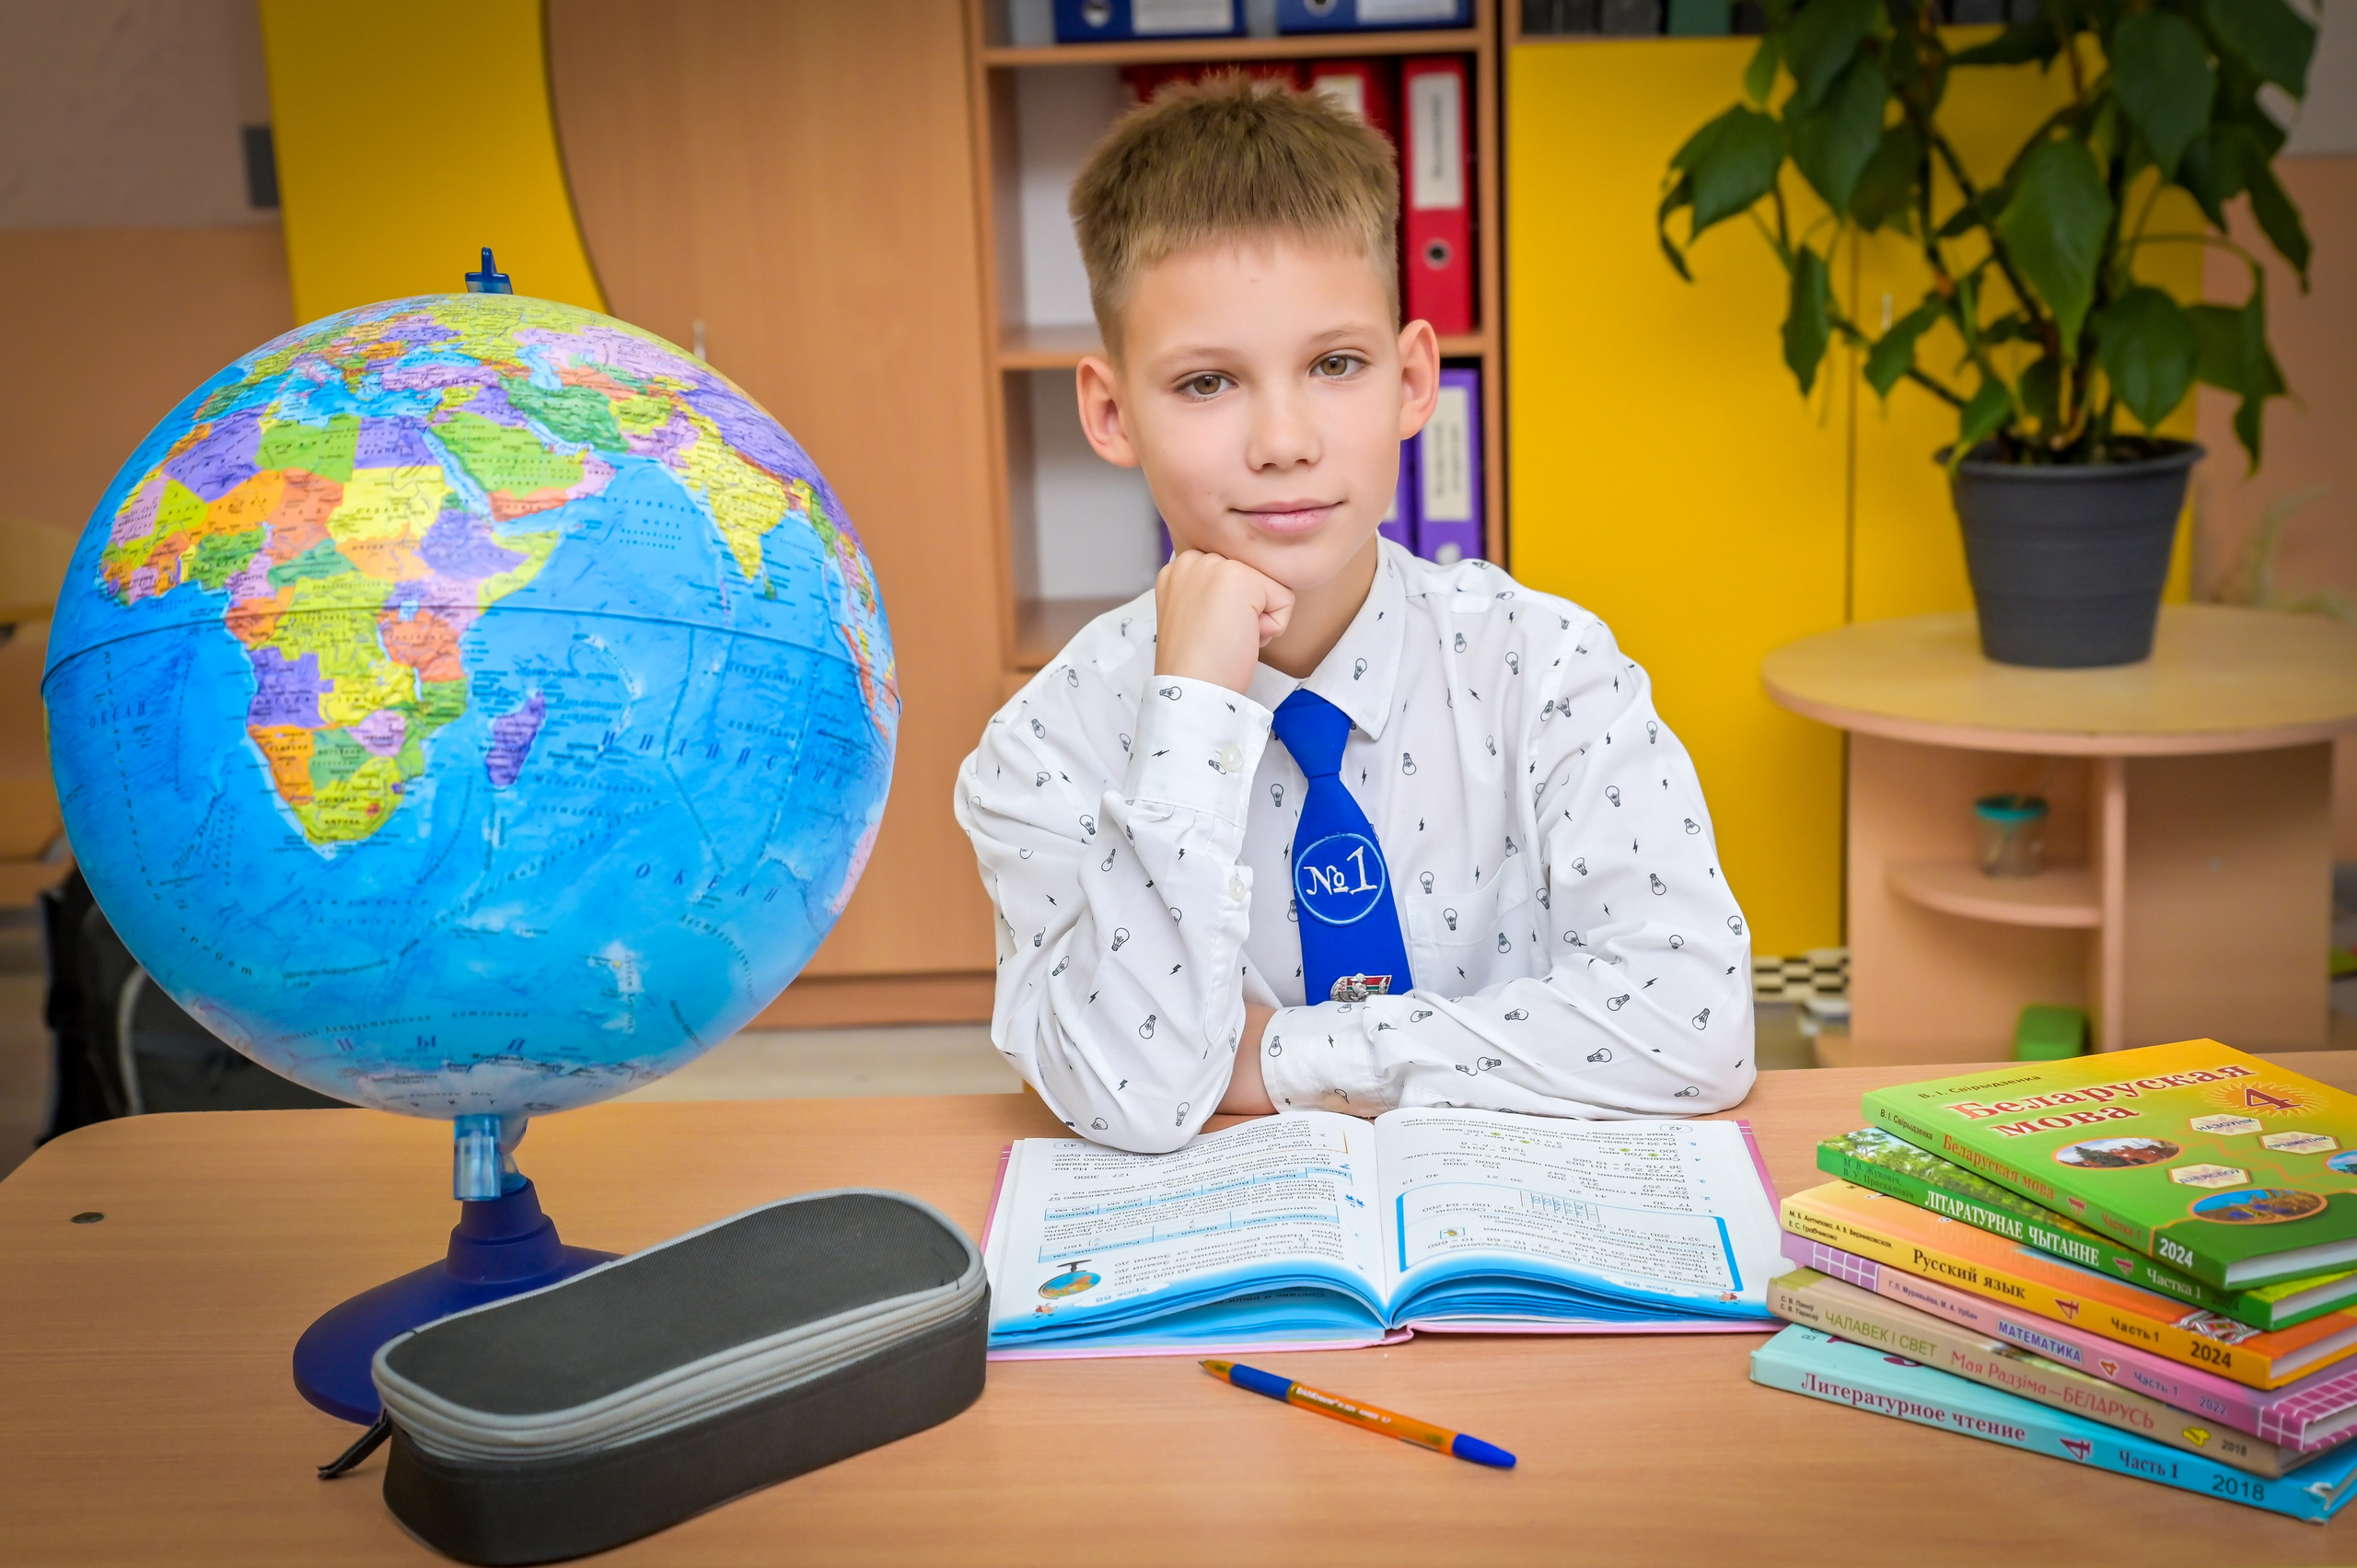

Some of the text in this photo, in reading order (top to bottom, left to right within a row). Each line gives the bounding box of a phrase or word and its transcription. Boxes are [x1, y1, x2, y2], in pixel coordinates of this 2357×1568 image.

[635, 863, 778, 902] ОКЕАН
[1303, 845, 1378, 896] №1
[1945, 1063, 2256, 1121] Беларуская
[1948, 1074, 2042, 1097] Свірыдзенка
[2246, 1087, 2303, 1110] 4
[1879, 1109, 1887, 1119] В.
[1893, 1113, 1933, 1141] Свірыдзенка
[1990, 1104, 2141, 1138] мова
[1842, 1157, 1853, 1170] М.
[1943, 1133, 2055, 1201] Беларуская мова
[1843, 1167, 1852, 1179] В.
[1864, 1173, 1914, 1201] Праскаловіч
[1788, 1209, 1796, 1218] М.
[2100, 1212, 2142, 1240] Частка 1
[1789, 1219, 1839, 1241] Е. С. Грабчикова
[1924, 1190, 2100, 1268] ЛІТАРАТУРНАЕ ЧЫТАННЕ
[2159, 1237, 2194, 1270] 2024
[1913, 1248, 2026, 1300] Русский язык
[2146, 1265, 2202, 1299] Частка 1
[1780, 1295, 1788, 1304] С.
[1780, 1303, 1787, 1311] С.
[2211, 1291, 2240, 1313] 2024
[1825, 1310, 1887, 1342] ЧАЛАВЕК
[1899, 1333, 1938, 1358] СВЕТ
[1998, 1318, 2082, 1364] МАТЕМАТИКА
[2109, 1316, 2160, 1342] Часть 1
[2099, 1359, 2118, 1378] 4
[2189, 1341, 2232, 1369] 2024
[1951, 1350, 1984, 1375] Мая
[2061, 1386, 2154, 1431] БЕЛАРУСЬ
[2133, 1371, 2179, 1396] Часть 1
[1801, 1372, 2026, 1442] Литературное чтение
[2198, 1396, 2227, 1416] 2022
[2221, 1438, 2247, 1457] 2018
[2118, 1449, 2178, 1479] Часть 1
[2212, 1473, 2265, 1502] 2018
